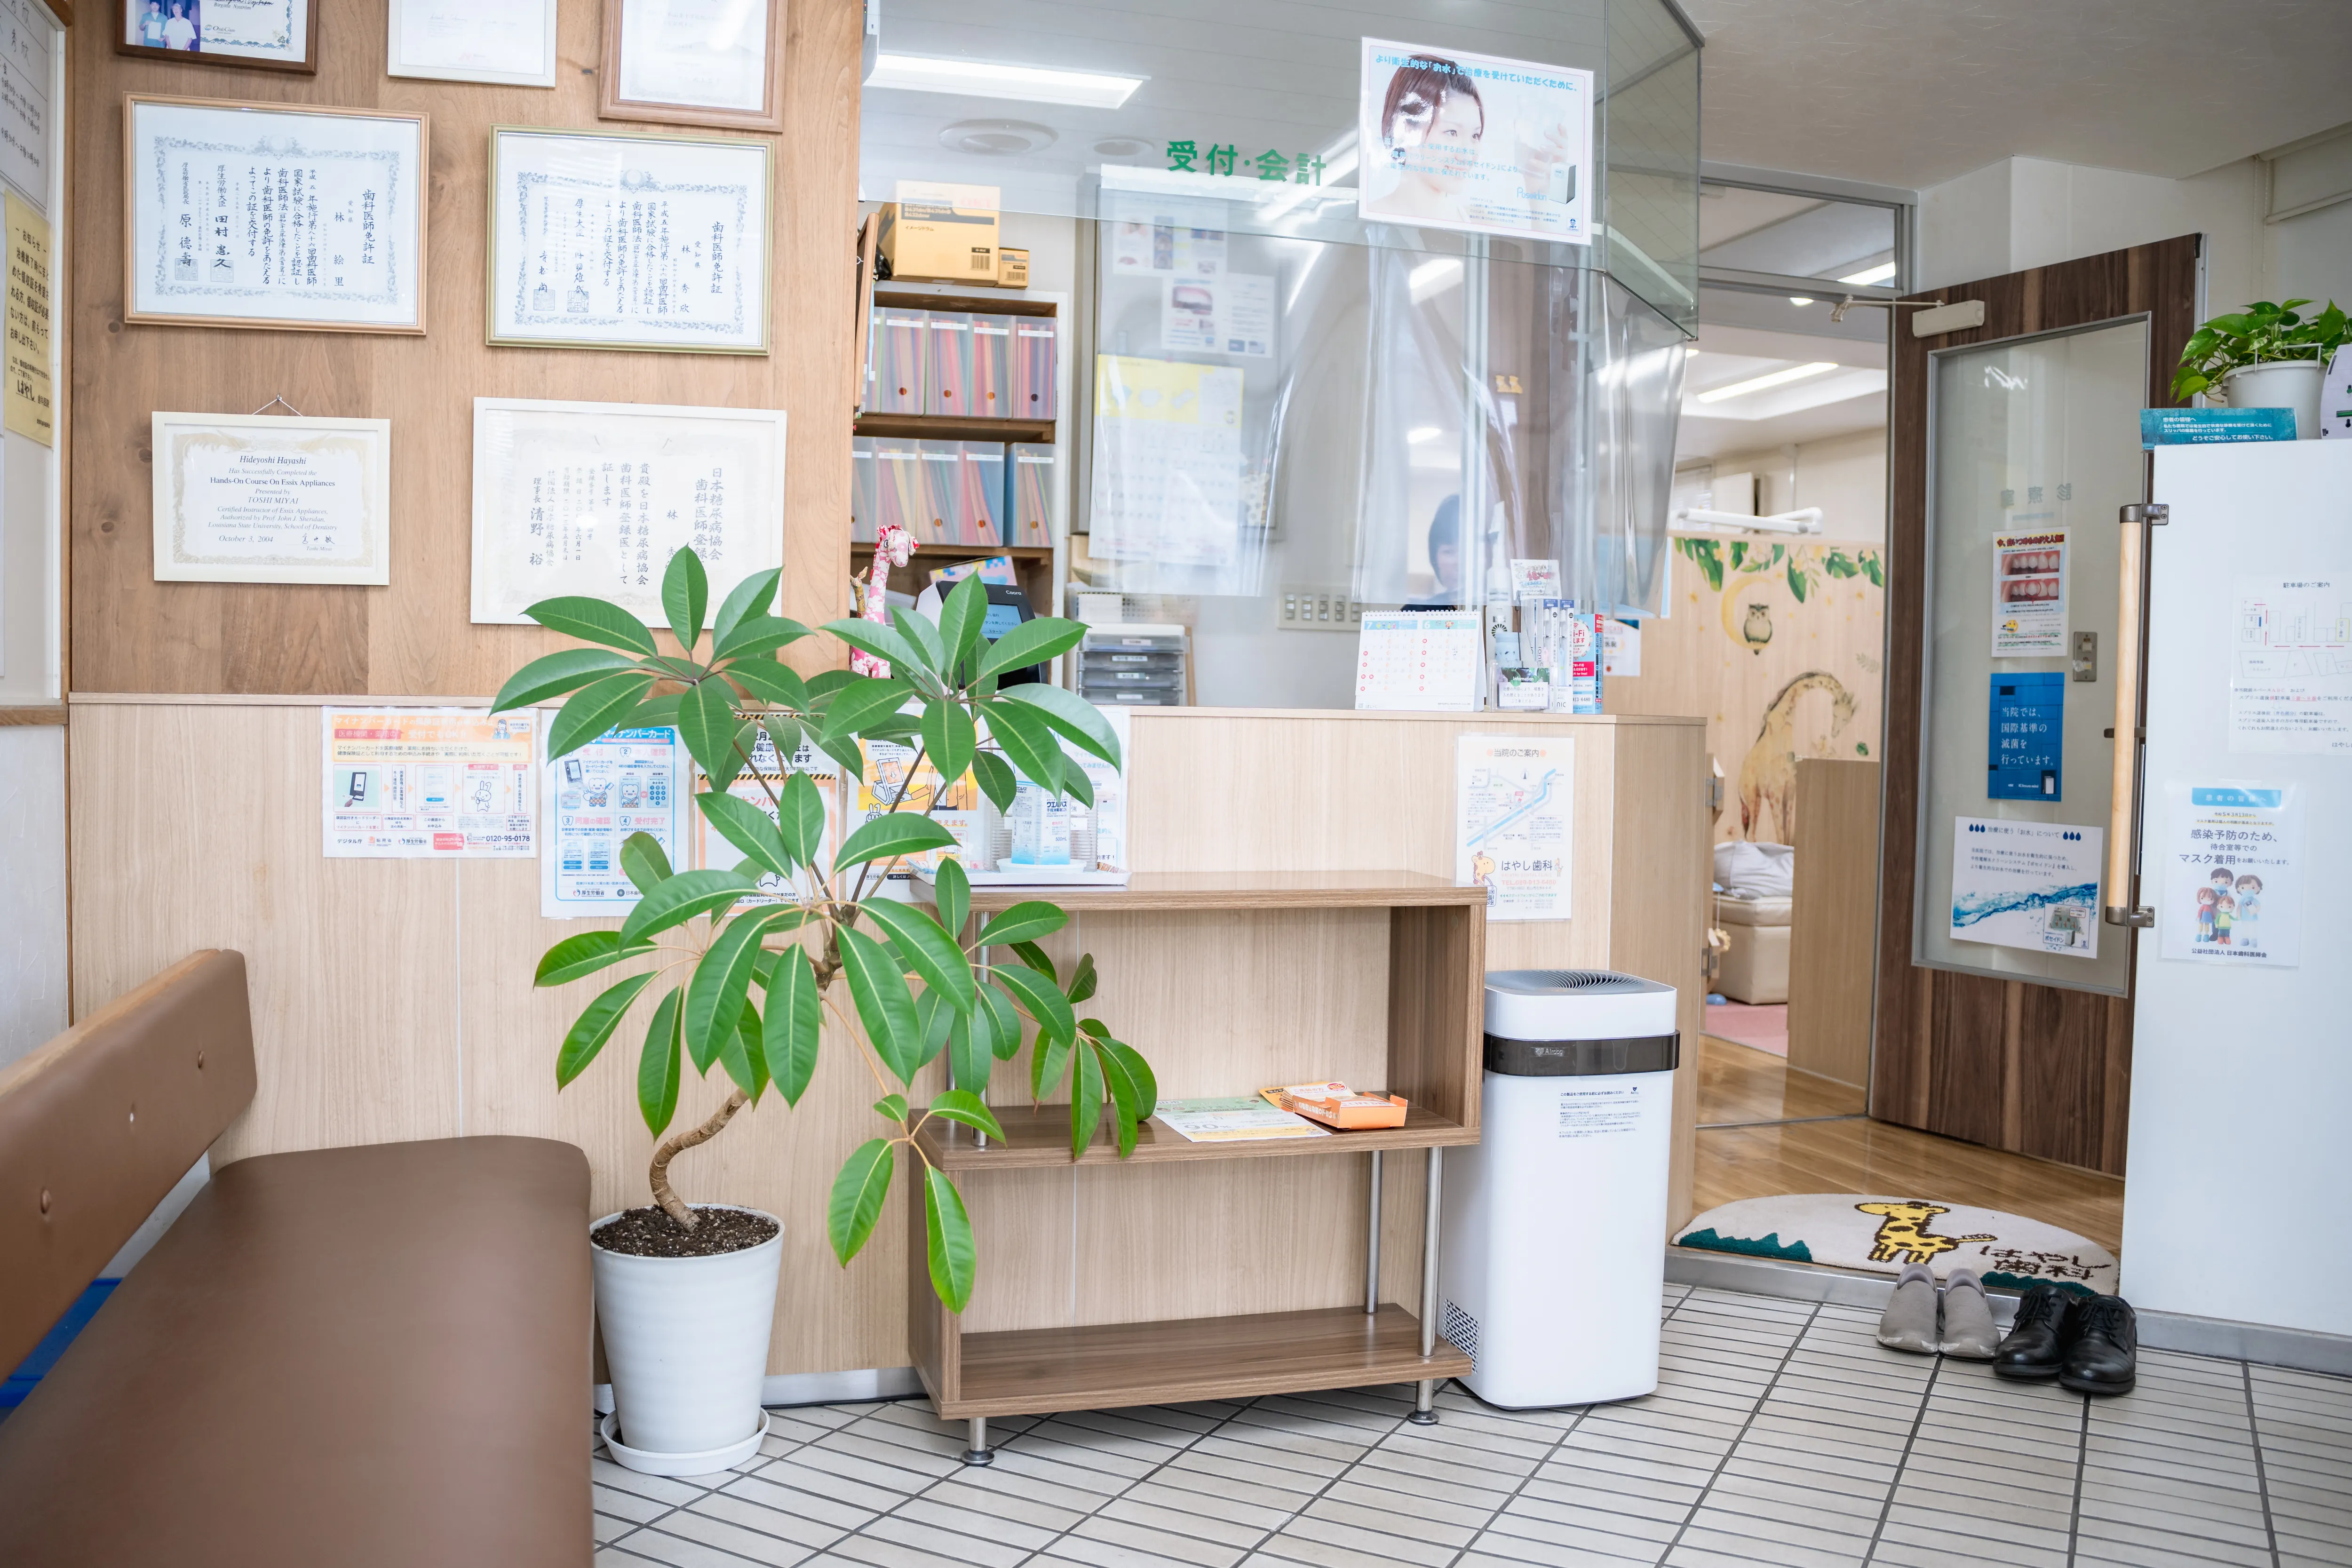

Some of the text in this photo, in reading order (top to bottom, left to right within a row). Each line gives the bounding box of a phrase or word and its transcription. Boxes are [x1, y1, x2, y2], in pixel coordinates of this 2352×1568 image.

[1375, 54, 1577, 91] より衛生的な「お水」で治療を受けていただくために。
[1167, 140, 1327, 186] 受付・会計
[217, 165, 227, 207] 厚生労働大臣
[246, 166, 258, 257] よってこの証を交付する
[262, 167, 274, 284] より歯科医師の免許をあたえる
[291, 169, 304, 285] 国家試験に合格したことを認証し
[362, 189, 376, 264] 歯科医師免許証
[616, 200, 628, 313] より歯科医師の免許をあたえる
[644, 202, 656, 314] 国家試験に合格したことを認証し
[711, 221, 724, 293] 歯科医師免許証
[17, 379, 35, 401] はやし
[239, 455, 307, 465] Hideyoshi Hayashi
[533, 478, 542, 503] 理事長
[602, 462, 613, 506] 証します
[546, 469, 556, 566] 社団法人日本糖尿病協会
[619, 462, 632, 584] 歯科医師登録医として
[636, 462, 651, 585] 貴殿を日本糖尿病協会
[694, 478, 708, 571] 歯科医師登録
[709, 468, 724, 560] 日本糖尿病協会
[2001, 707, 2042, 718] 当院では、
[2001, 723, 2047, 734] 国際基準の
[1494, 748, 1539, 757] 当院のご案内
[2001, 738, 2027, 749] 滅菌を
[2001, 754, 2055, 766] 行っています。
[1988, 826, 2060, 837] 治療に使う「お水」について
[2190, 828, 2277, 842] 感染予防のため、
[2209, 843, 2257, 852] 待合室等での
[1502, 860, 1552, 871] はやし歯科
[2179, 854, 2289, 866] マスク着用をお願いいたします。
[1979, 1245, 2111, 1268] はやし
[1994, 1259, 2094, 1280] 歯科
